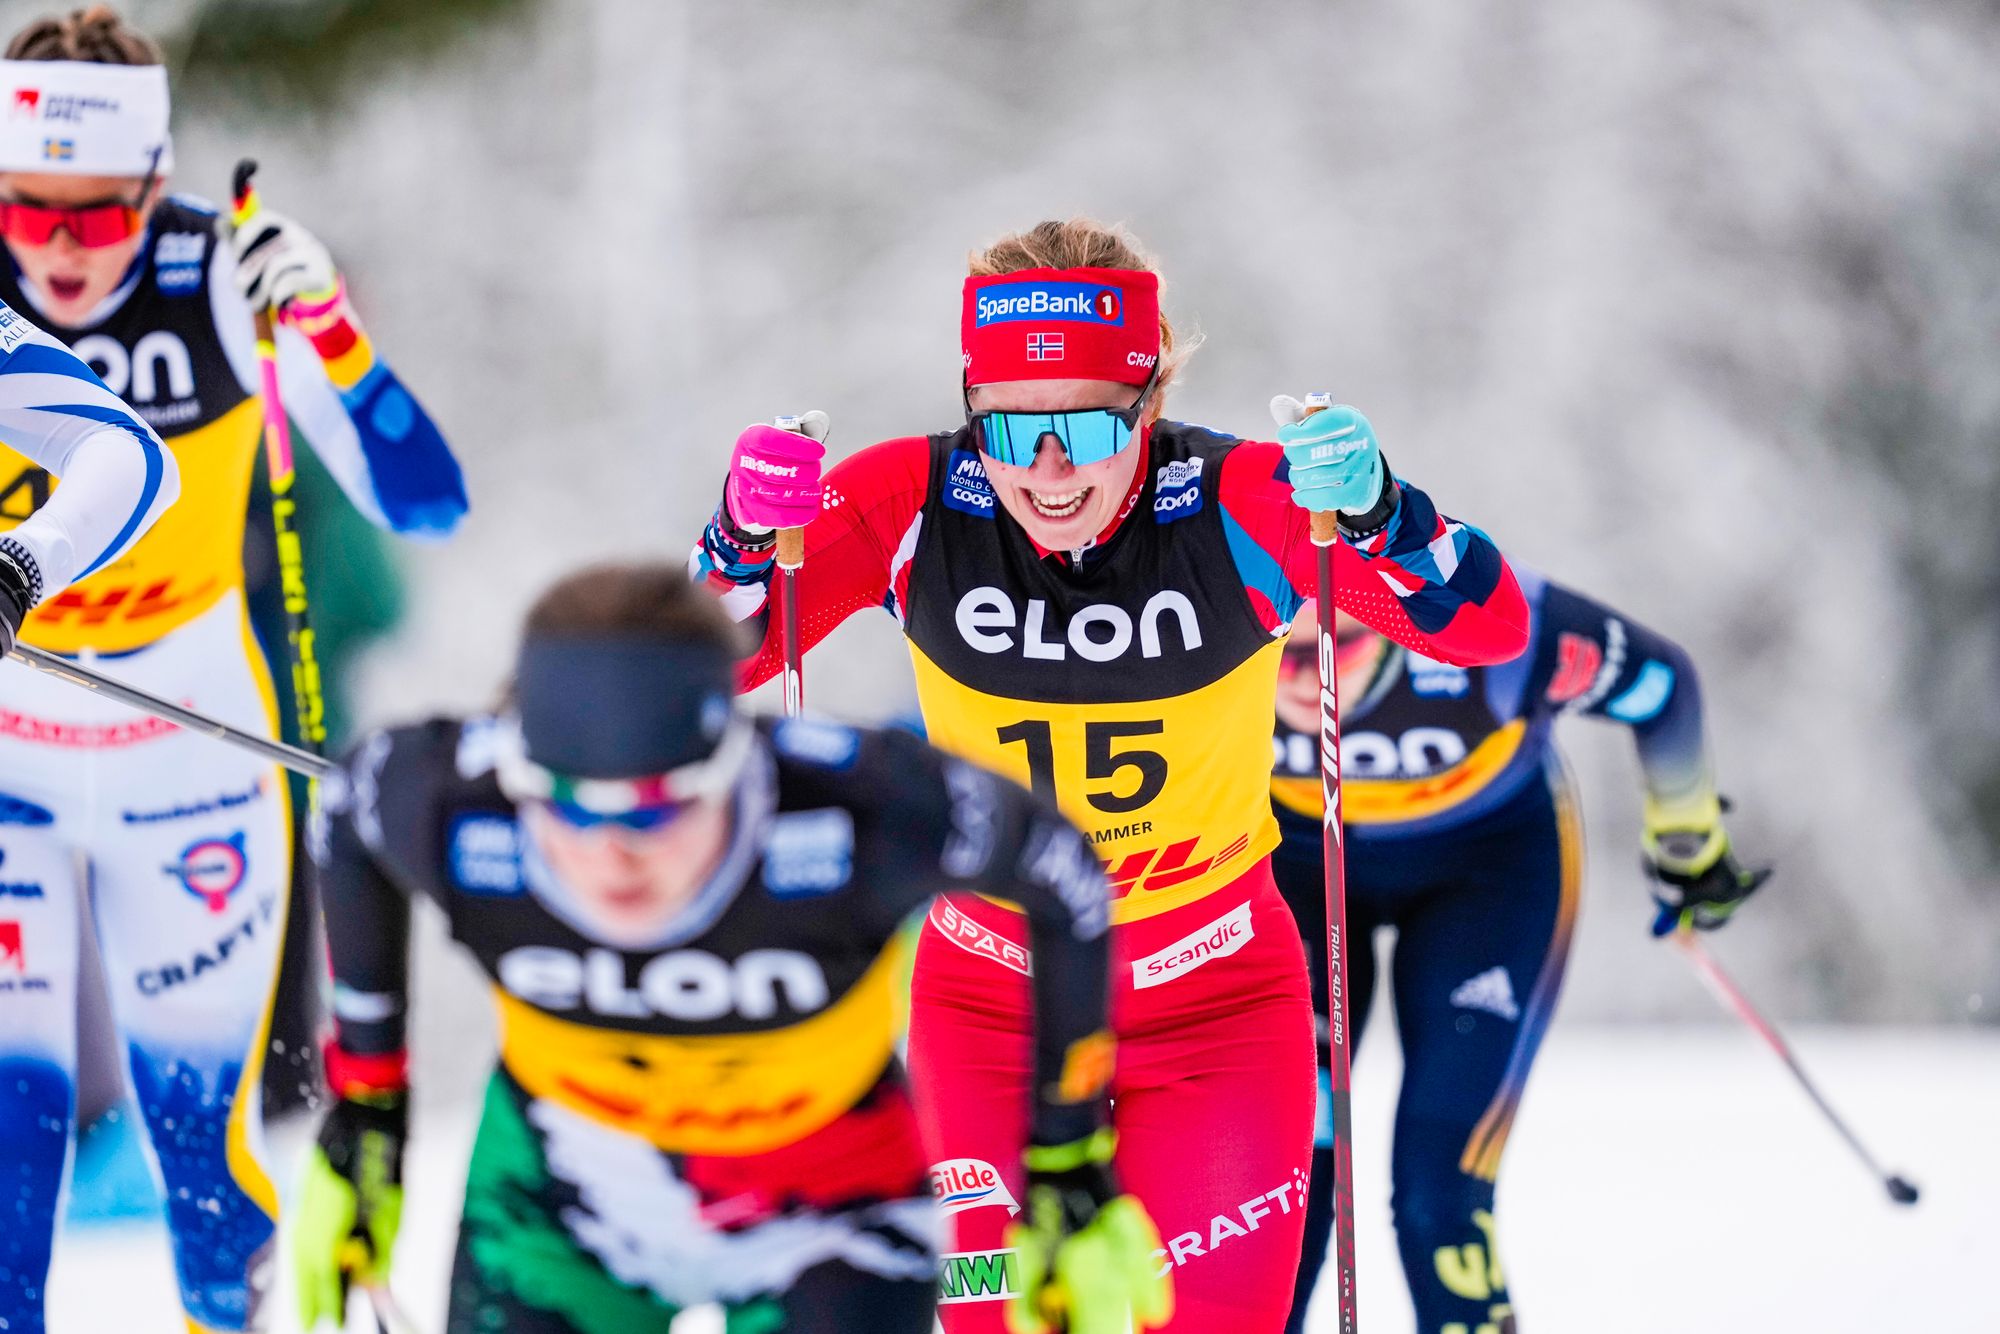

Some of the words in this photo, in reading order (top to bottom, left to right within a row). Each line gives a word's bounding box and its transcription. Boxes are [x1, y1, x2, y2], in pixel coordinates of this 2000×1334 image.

[977, 290, 1092, 321] SpareBank
[1101, 295, 1112, 316] 1
[1126, 351, 1157, 369] CRAF
[951, 473, 983, 490] WORLD
[952, 487, 994, 509] coop
[1317, 624, 1341, 848] SWIX
[996, 718, 1169, 814] 15
[1082, 820, 1153, 845] AMMER
[940, 905, 1027, 969] SPAR
[1146, 920, 1243, 977] Scandic
[1330, 924, 1341, 972] TRIAC
[1333, 997, 1343, 1045] AERO
[931, 1164, 996, 1198] Gilde
[1149, 1181, 1293, 1281] CRAFT
